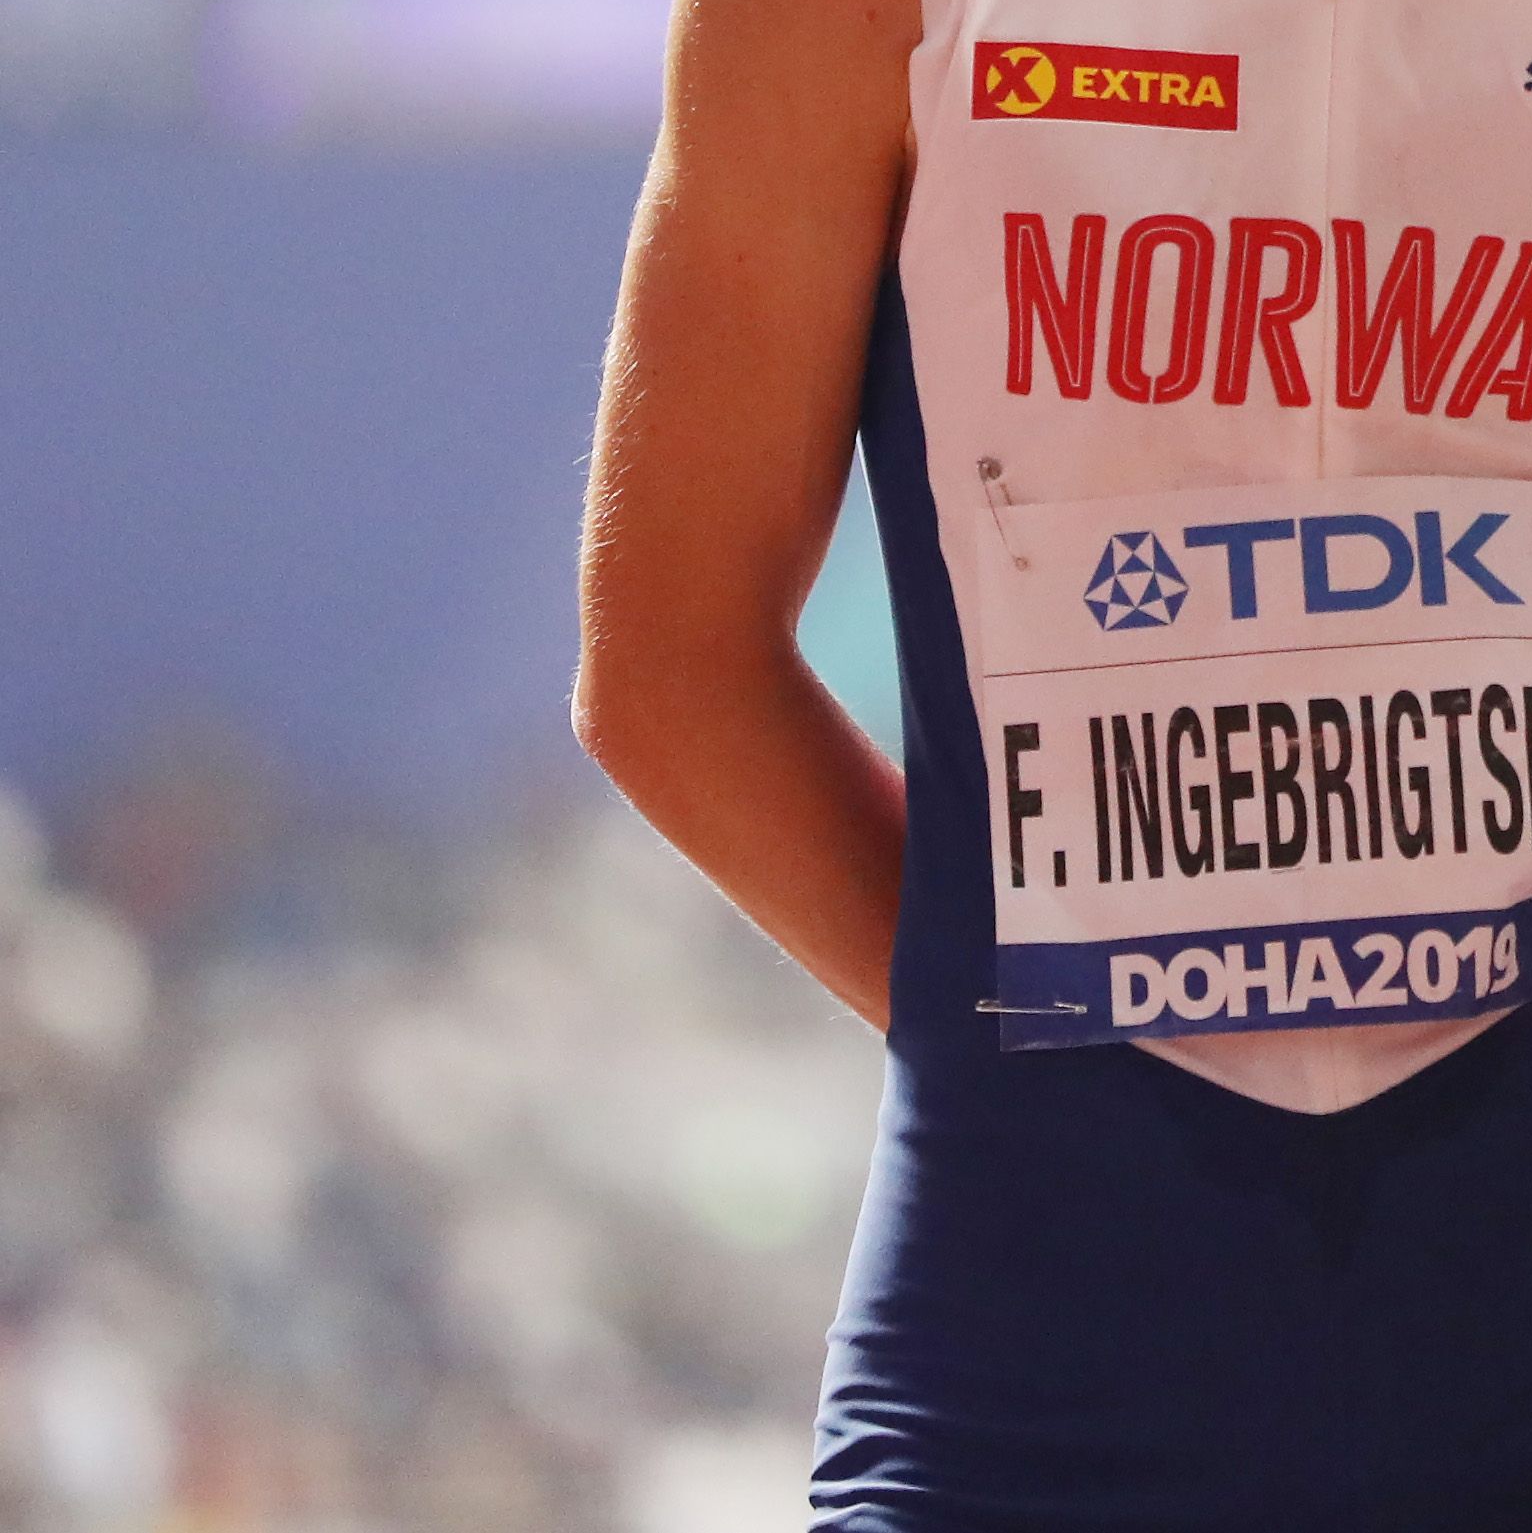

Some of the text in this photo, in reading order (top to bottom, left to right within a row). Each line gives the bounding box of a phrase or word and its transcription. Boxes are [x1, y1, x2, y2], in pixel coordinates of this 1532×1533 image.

[1072, 66, 1226, 108] EXTRA
[1184, 511, 1524, 620] TDK
[1003, 722, 1067, 889] F.
[1109, 923, 1519, 1027] DOHA2019
